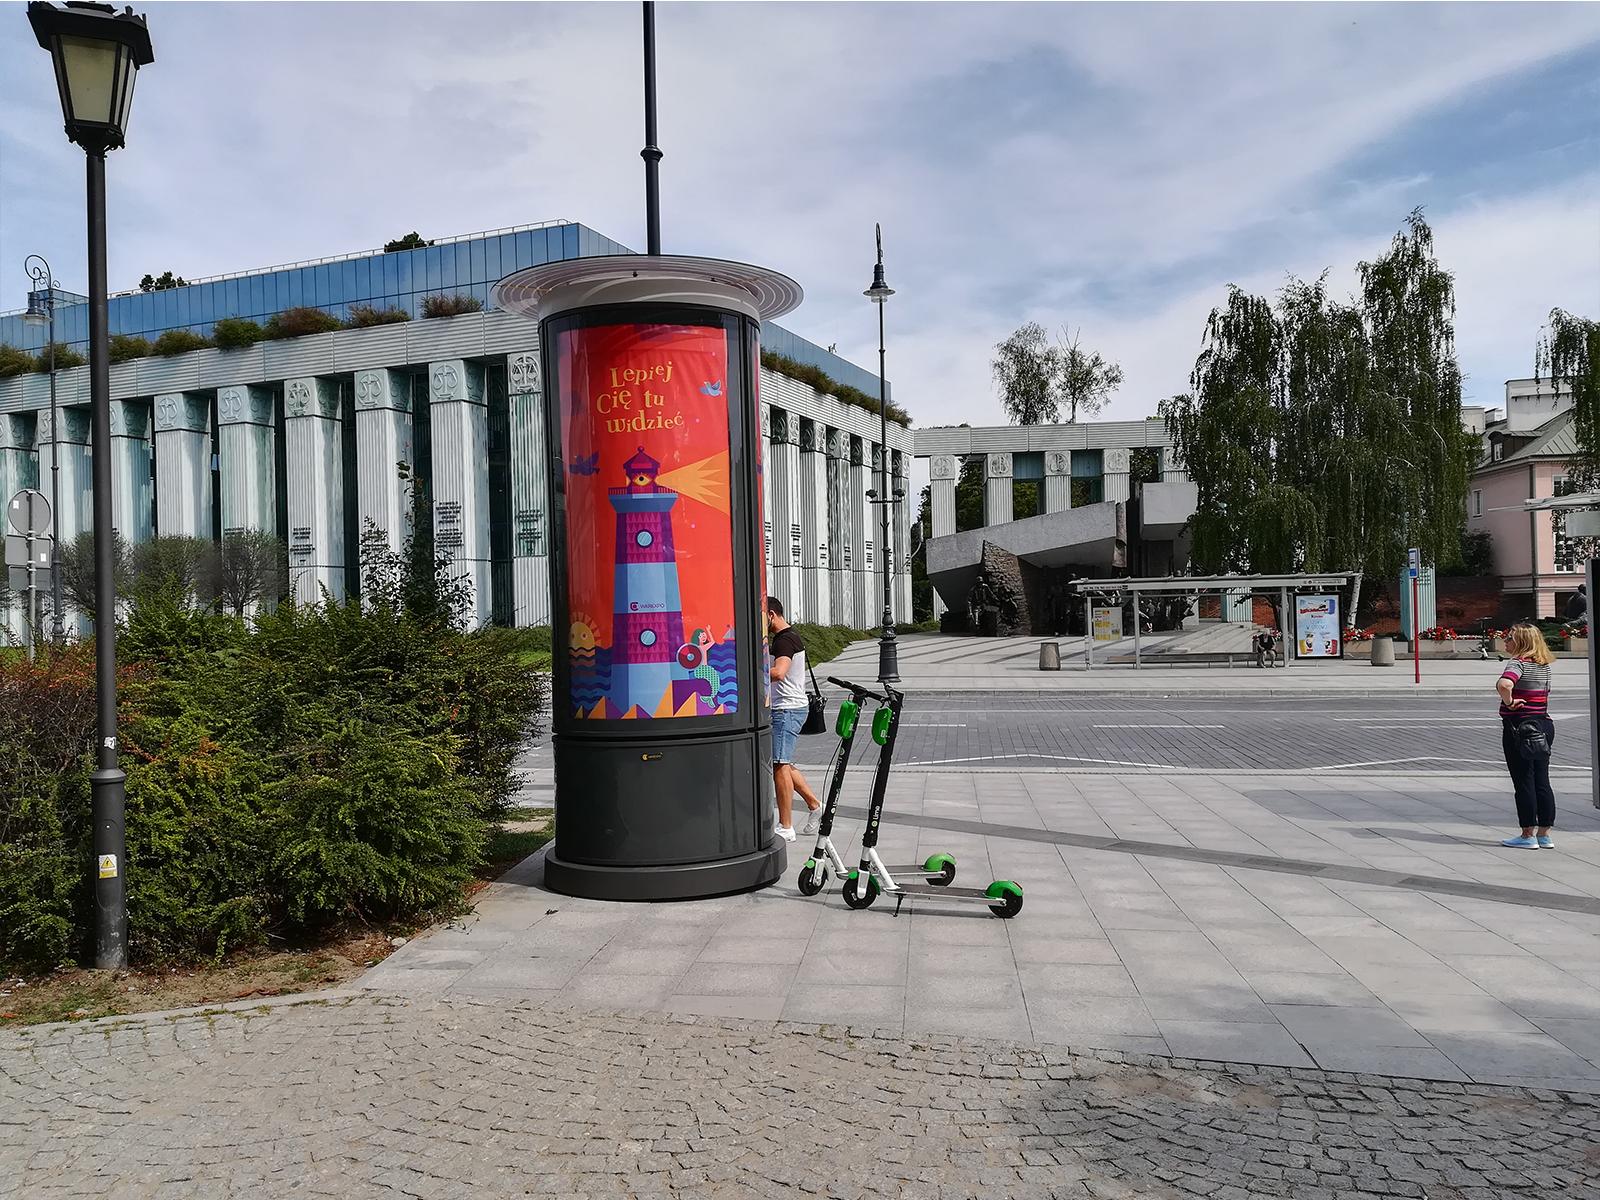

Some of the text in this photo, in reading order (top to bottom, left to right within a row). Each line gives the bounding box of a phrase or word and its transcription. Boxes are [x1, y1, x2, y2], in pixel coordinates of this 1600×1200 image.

[610, 361, 673, 388] Lepiej
[597, 389, 664, 414] Cię tu
[606, 409, 684, 433] widzieć
